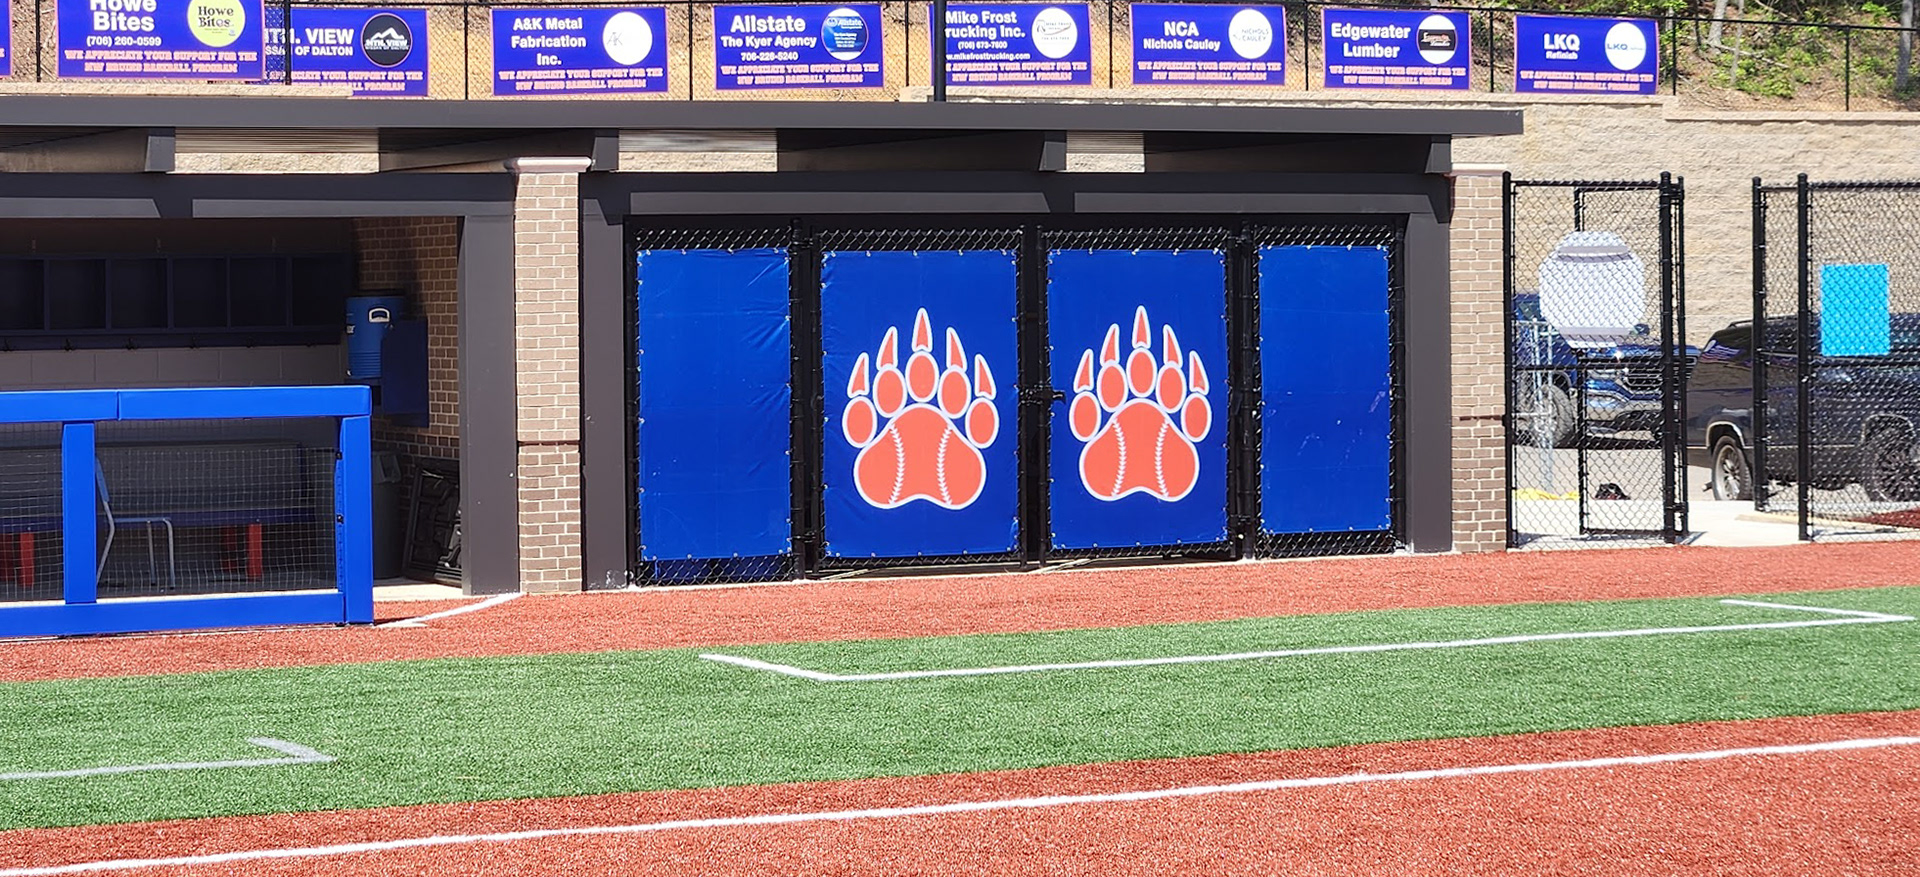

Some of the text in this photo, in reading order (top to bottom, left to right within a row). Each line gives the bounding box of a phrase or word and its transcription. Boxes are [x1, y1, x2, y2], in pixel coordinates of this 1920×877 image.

[198, 6, 234, 16] Howe
[945, 11, 1017, 24] Mike Frost
[94, 11, 155, 31] Bites
[198, 16, 231, 27] Bites
[513, 17, 583, 30] A&K Metal
[730, 15, 806, 33] Allstate
[944, 25, 1026, 40] rucking Inc.
[1164, 21, 1199, 36] NCA
[1331, 23, 1411, 41] Edgewater
[86, 36, 162, 47] (706) 260-0599
[305, 28, 354, 44] VIEW
[511, 35, 586, 48] Fabrication
[720, 36, 817, 49] The Kyer Agency
[1543, 34, 1580, 51] LKQ
[295, 46, 310, 55] OF
[312, 46, 353, 55] DALTON
[1143, 39, 1220, 51] Nichols Cauley
[1343, 43, 1400, 58] Lumber
[1607, 43, 1628, 51] LKQ
[537, 53, 562, 65] Inc.
